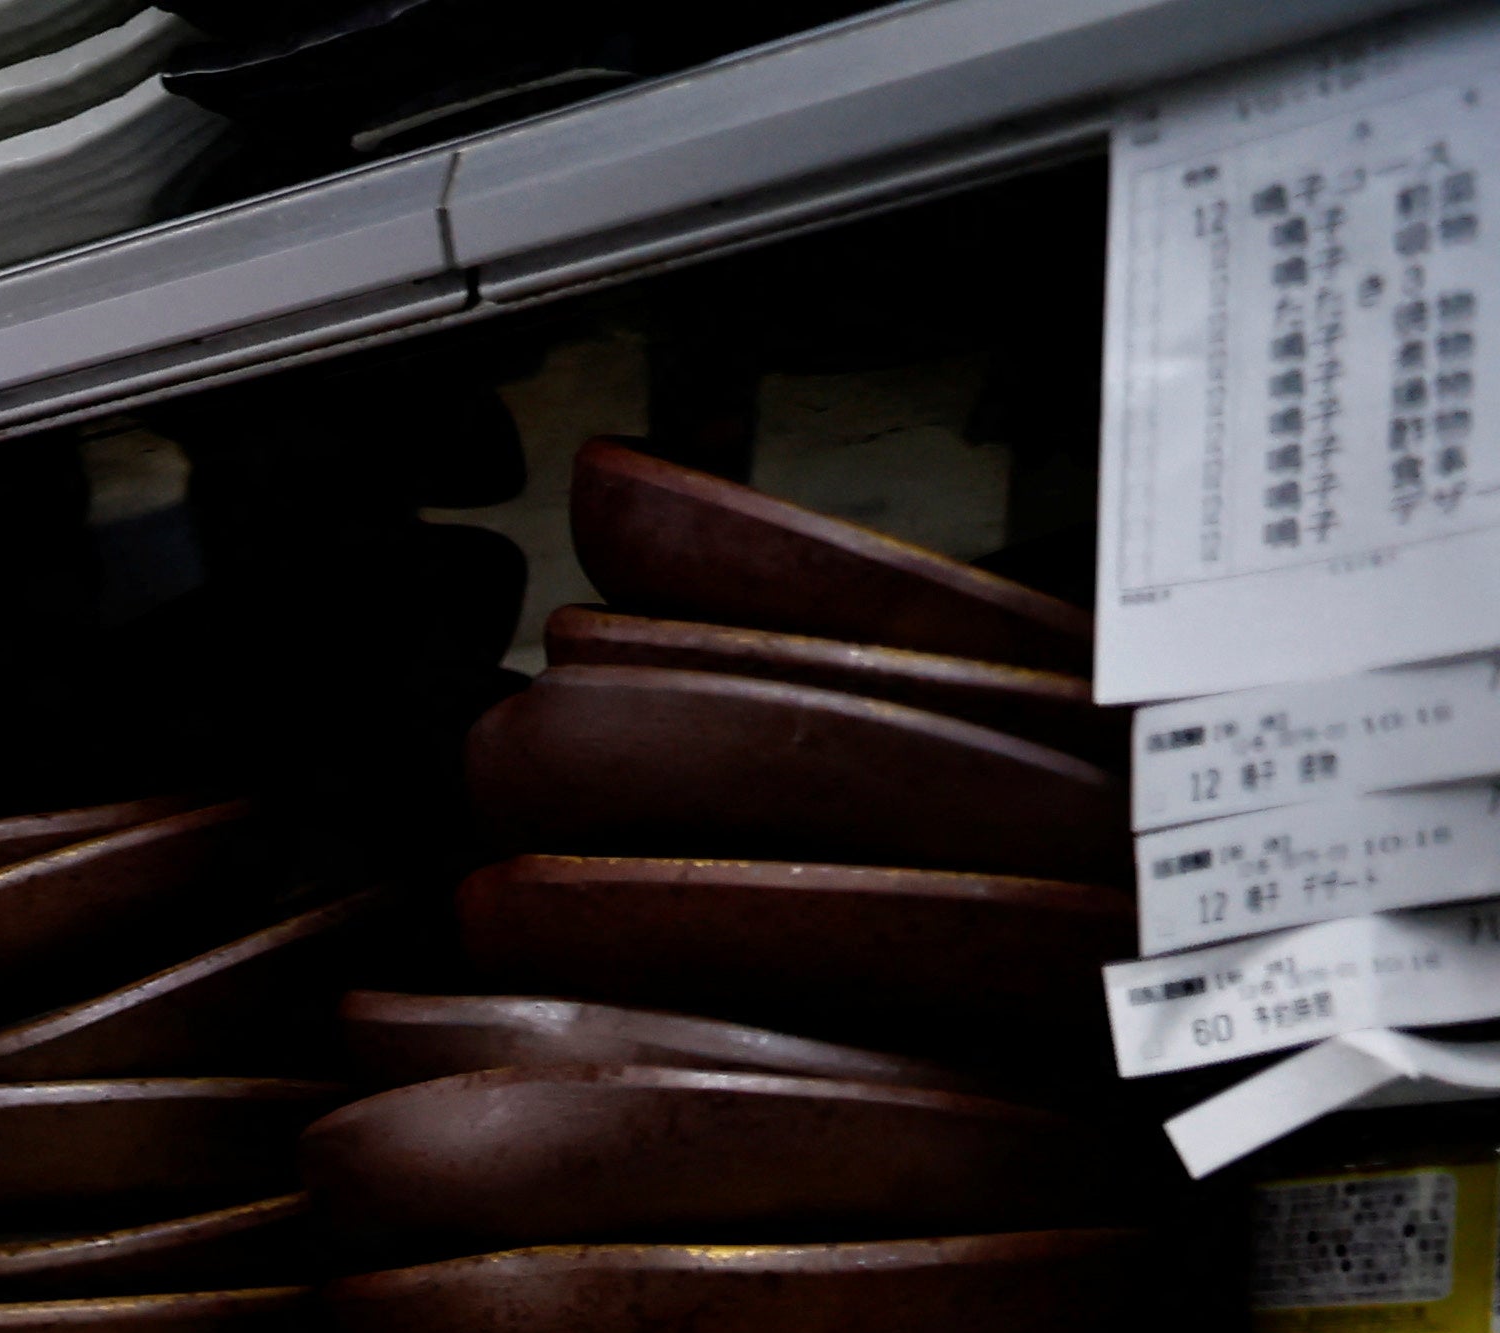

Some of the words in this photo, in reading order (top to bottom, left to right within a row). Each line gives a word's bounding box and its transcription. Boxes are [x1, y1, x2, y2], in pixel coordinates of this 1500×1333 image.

[1193, 200, 1227, 238] 12
[1189, 768, 1221, 802] 12
[1198, 890, 1228, 925] 12
[1191, 1014, 1234, 1047] 60
